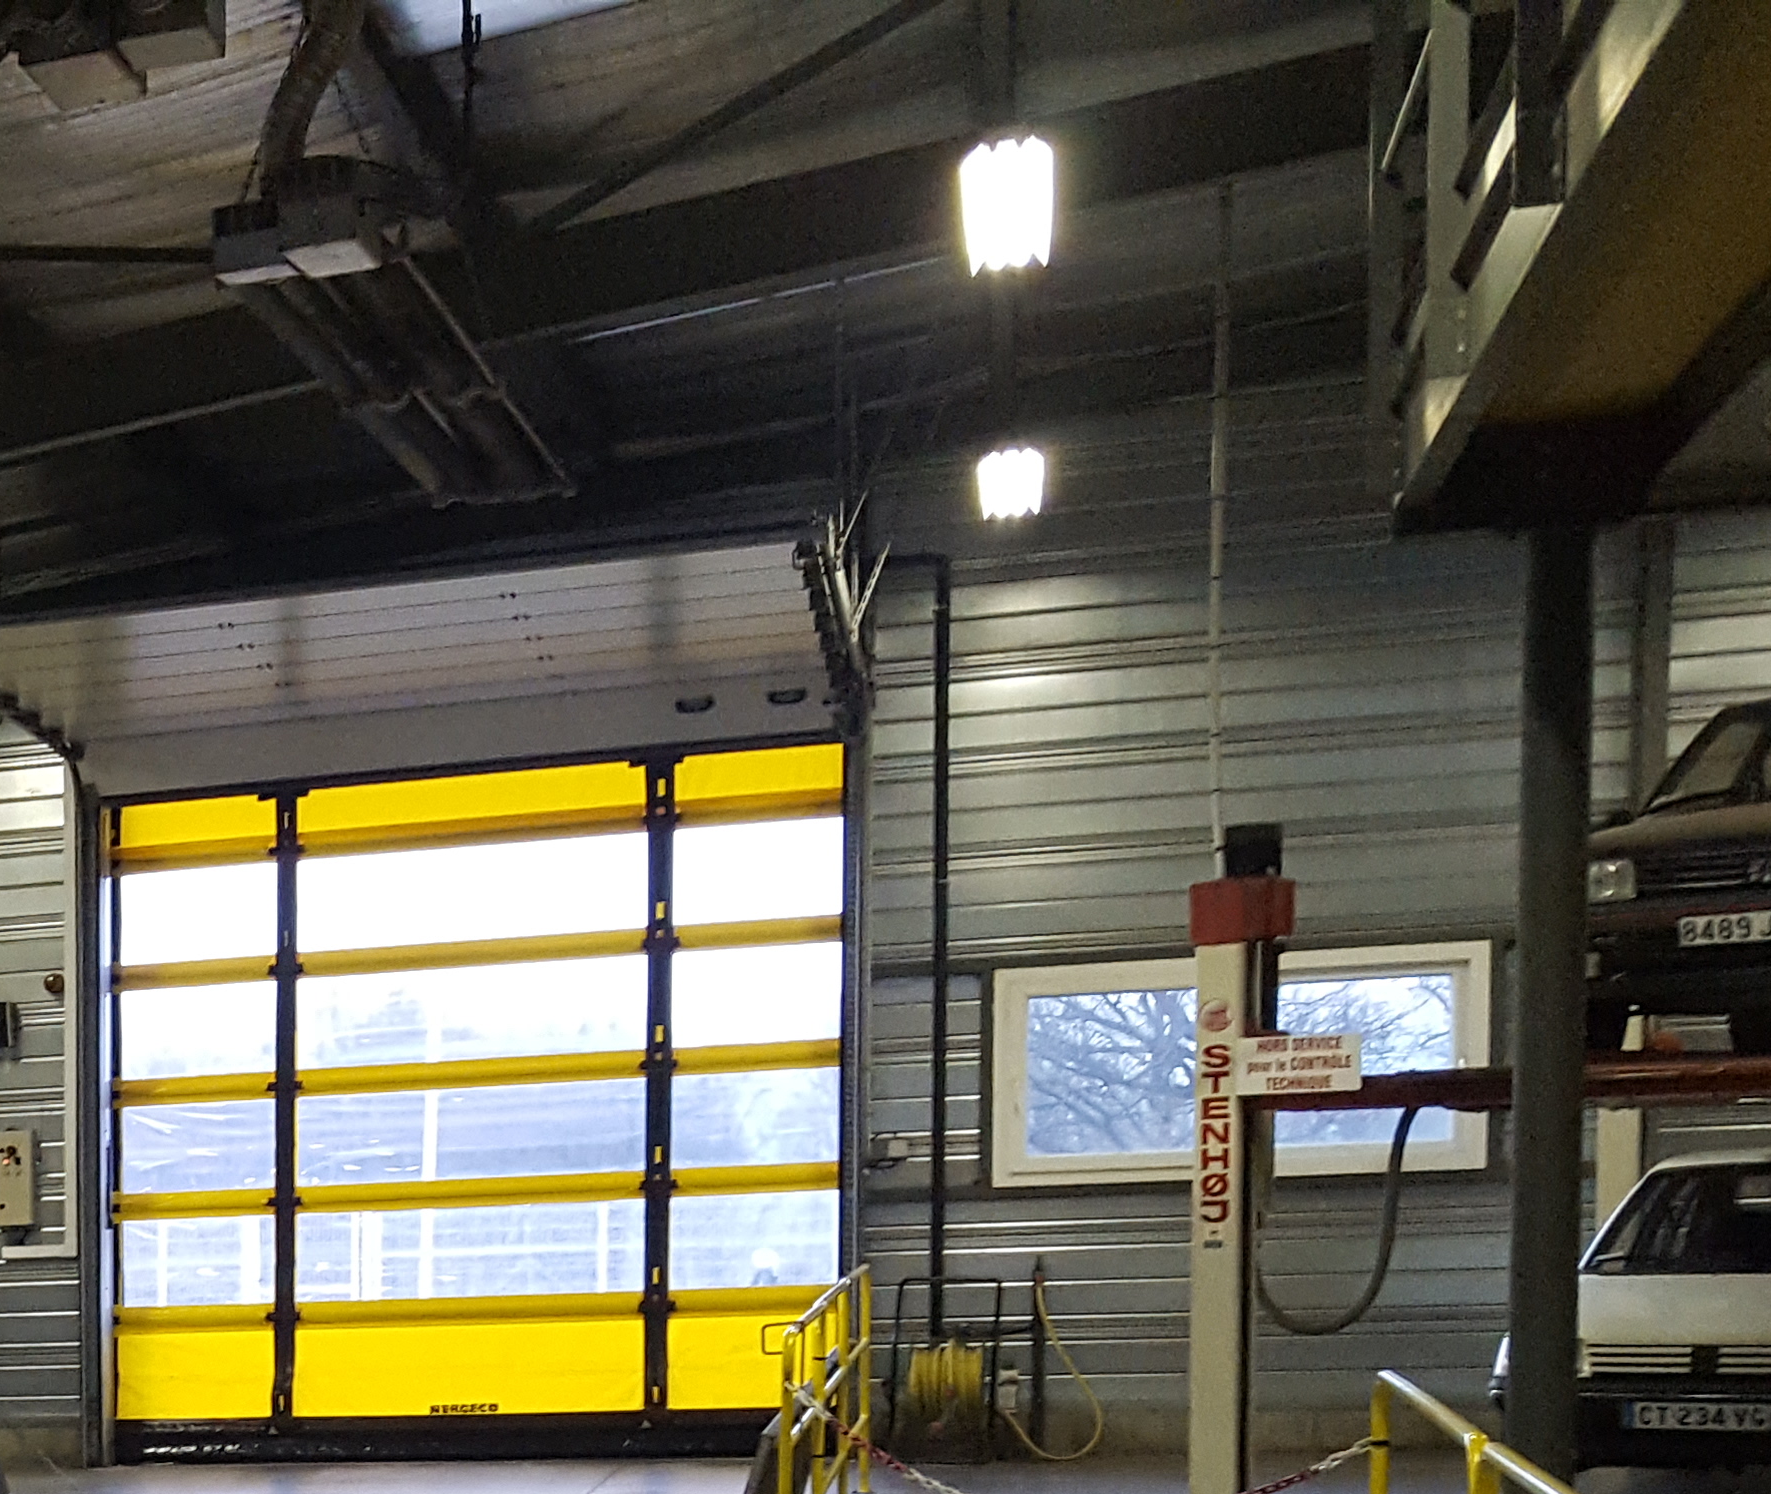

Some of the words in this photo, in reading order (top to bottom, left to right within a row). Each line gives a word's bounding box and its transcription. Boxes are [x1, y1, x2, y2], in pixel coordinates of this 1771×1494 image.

[1681, 915, 1752, 942] 8489
[1200, 1044, 1231, 1224] STENHØJ
[429, 1402, 499, 1415] NERGECO
[1638, 1404, 1669, 1426] CT
[1677, 1405, 1726, 1427] 234
